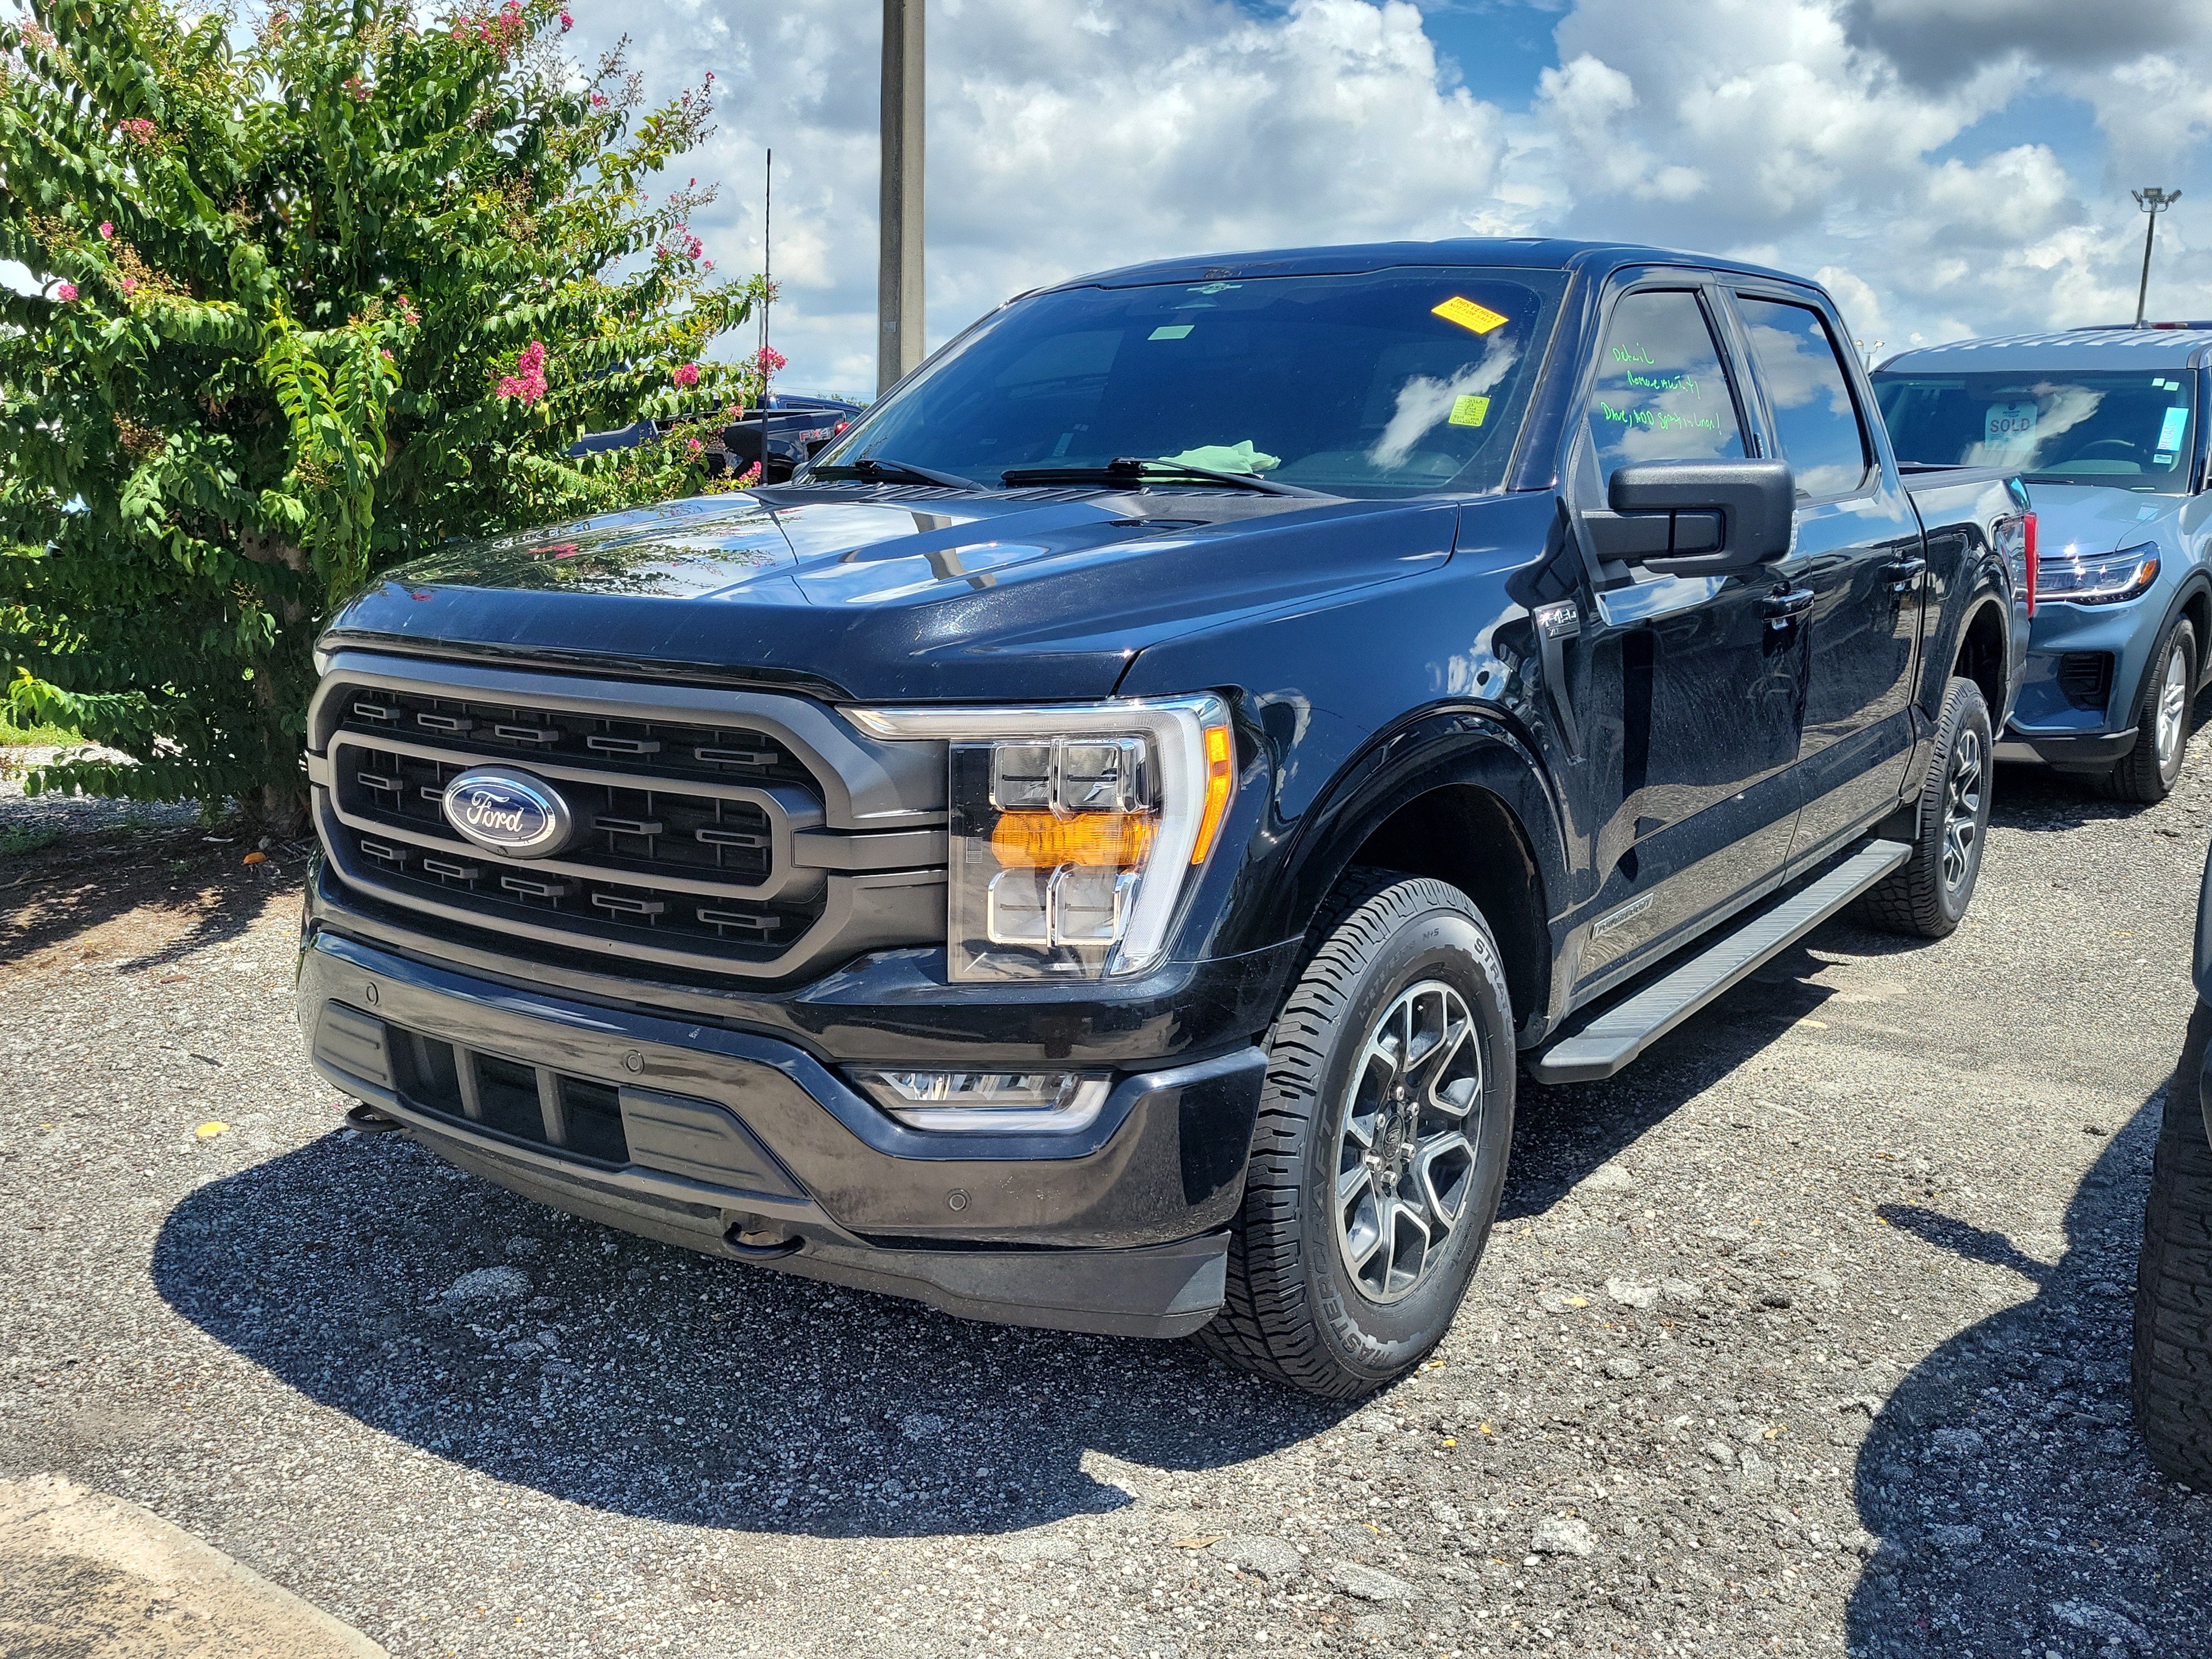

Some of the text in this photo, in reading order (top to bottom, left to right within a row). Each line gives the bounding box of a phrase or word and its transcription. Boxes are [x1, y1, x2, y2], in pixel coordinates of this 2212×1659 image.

[1454, 299, 1471, 308] THIS
[1471, 306, 1500, 321] VEHICLE
[1462, 308, 1476, 317] FOR
[1990, 418, 2030, 432] SOLD
[799, 428, 831, 442] FX4
[2159, 423, 2176, 449] RECALL
[467, 790, 524, 832] Ford
